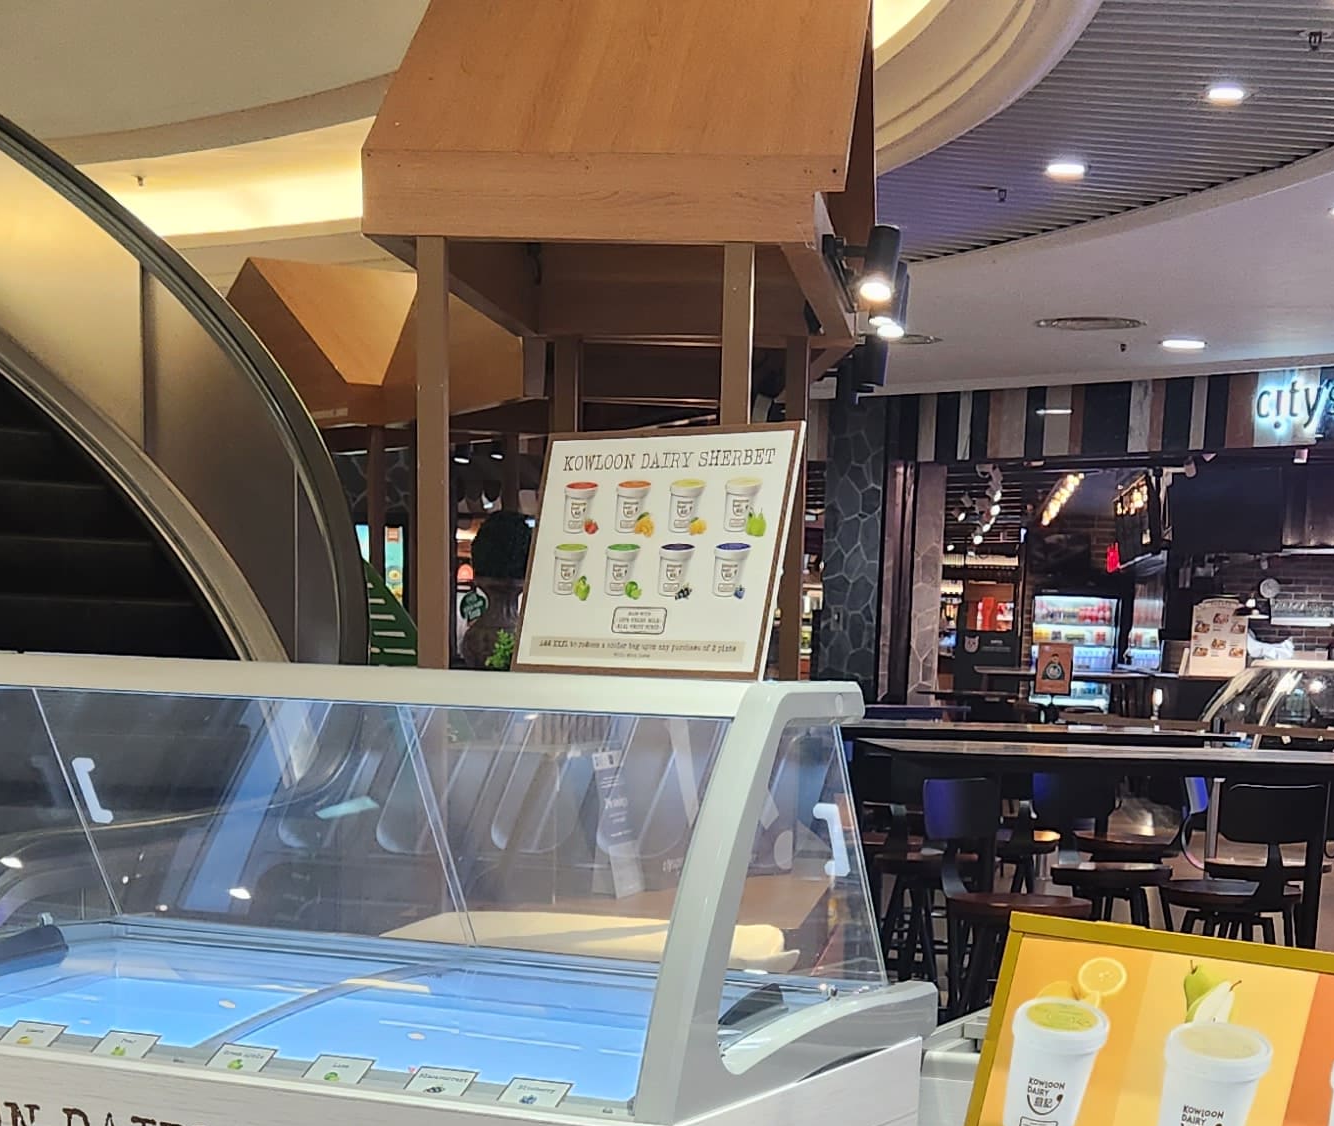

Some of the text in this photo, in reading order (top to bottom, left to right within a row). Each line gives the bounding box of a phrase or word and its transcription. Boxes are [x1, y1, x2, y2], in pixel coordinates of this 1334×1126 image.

[563, 448, 776, 471] KOWLOON DAIRY SHERBET
